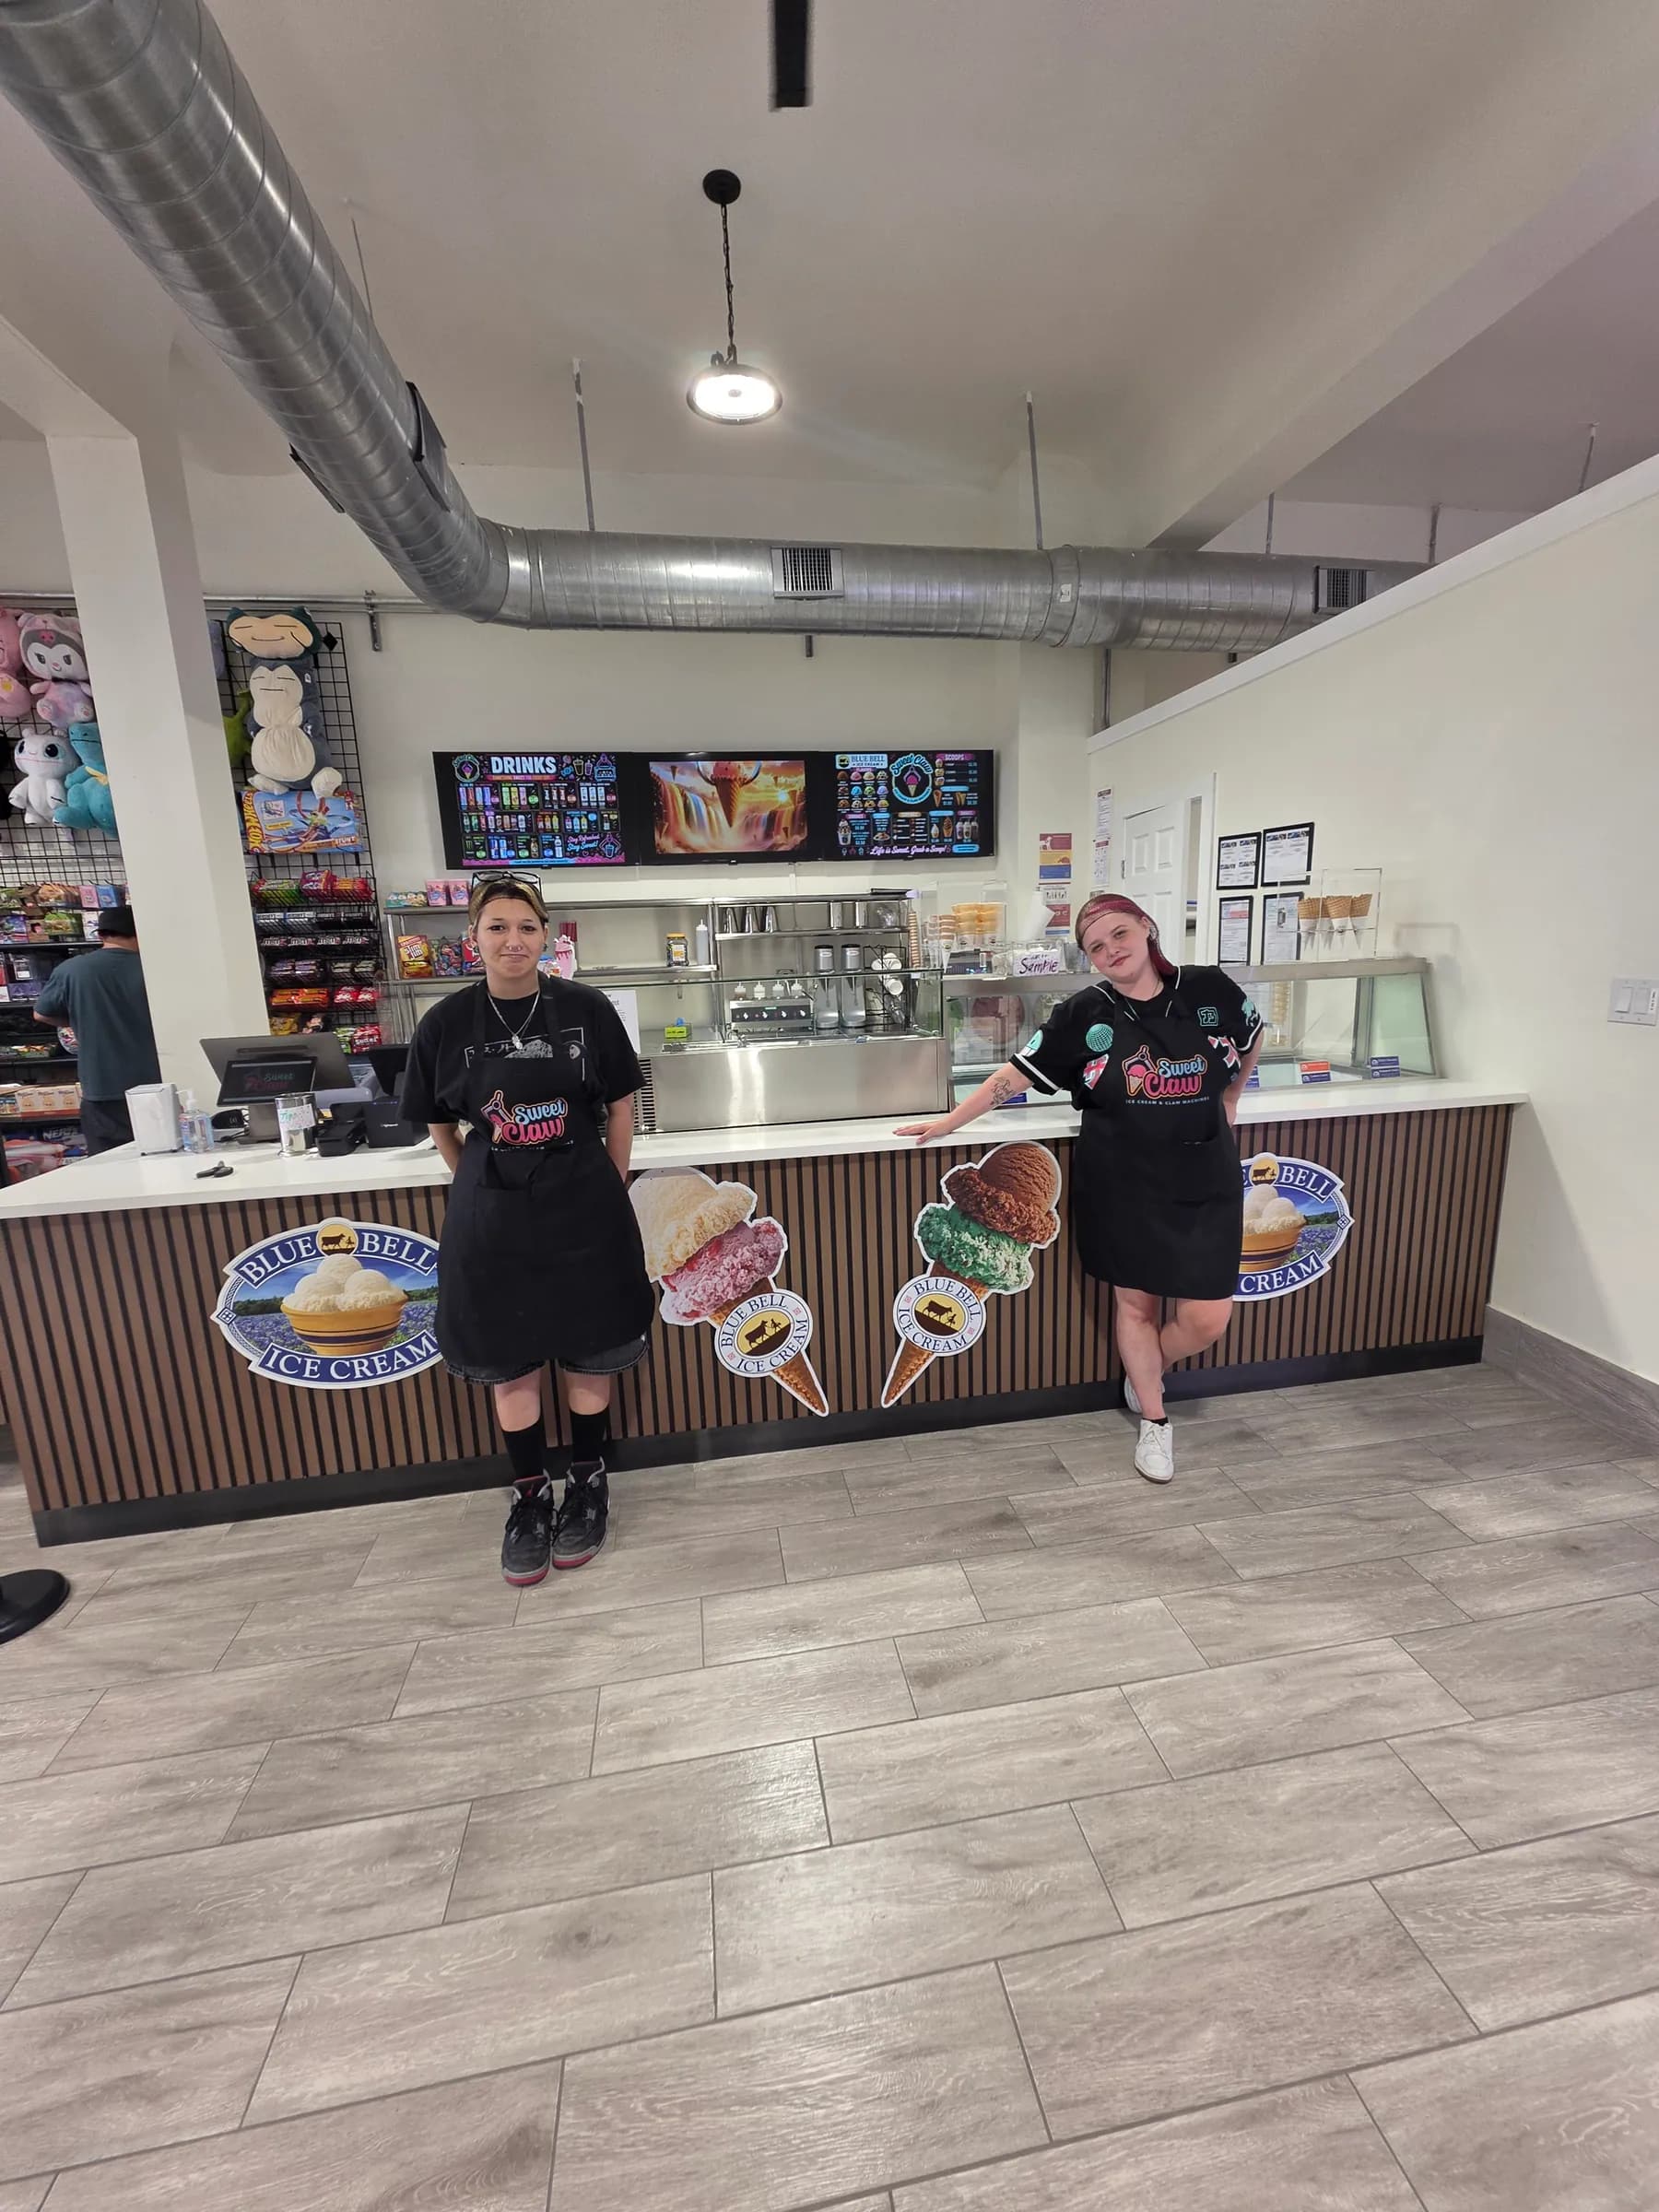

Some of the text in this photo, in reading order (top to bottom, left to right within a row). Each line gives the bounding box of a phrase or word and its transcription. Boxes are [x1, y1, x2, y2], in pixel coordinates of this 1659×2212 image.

[490, 757, 557, 774] DRINKS
[889, 754, 914, 775] Sweet
[914, 756, 933, 773] Claw
[567, 842, 580, 852] Stay
[870, 846, 885, 856] Life
[1159, 1057, 1206, 1077] Sweet
[1145, 1072, 1199, 1097] Claw
[515, 1100, 565, 1124] Sweet
[501, 1118, 562, 1143] Claw
[1280, 1165, 1333, 1198] BELL
[239, 1232, 437, 1284] BLUE BELL
[1240, 1255, 1321, 1293] CREAM
[913, 1278, 982, 1320] BLUE BELL
[721, 1294, 787, 1347] BLUE BELL
[899, 1309, 967, 1351] ICE CREAM
[265, 1335, 438, 1381] ICE CREAM
[737, 1319, 808, 1372] ICE CREAM
